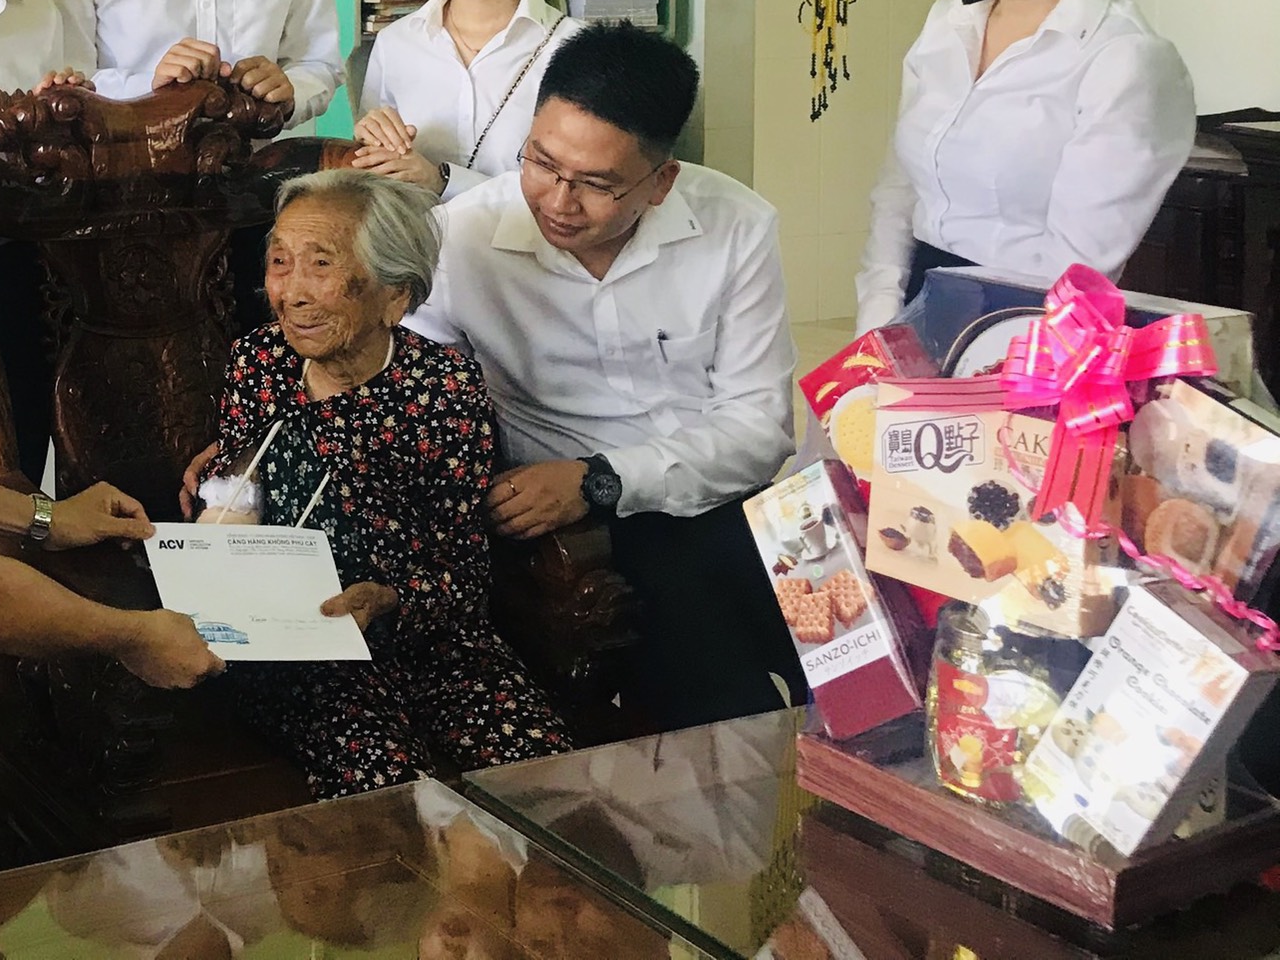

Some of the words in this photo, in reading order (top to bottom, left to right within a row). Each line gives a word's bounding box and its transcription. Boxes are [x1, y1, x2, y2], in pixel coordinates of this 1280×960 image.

[996, 426, 1049, 457] CAK
[158, 539, 185, 550] ACV
[805, 629, 881, 672] SANZO-ICHI
